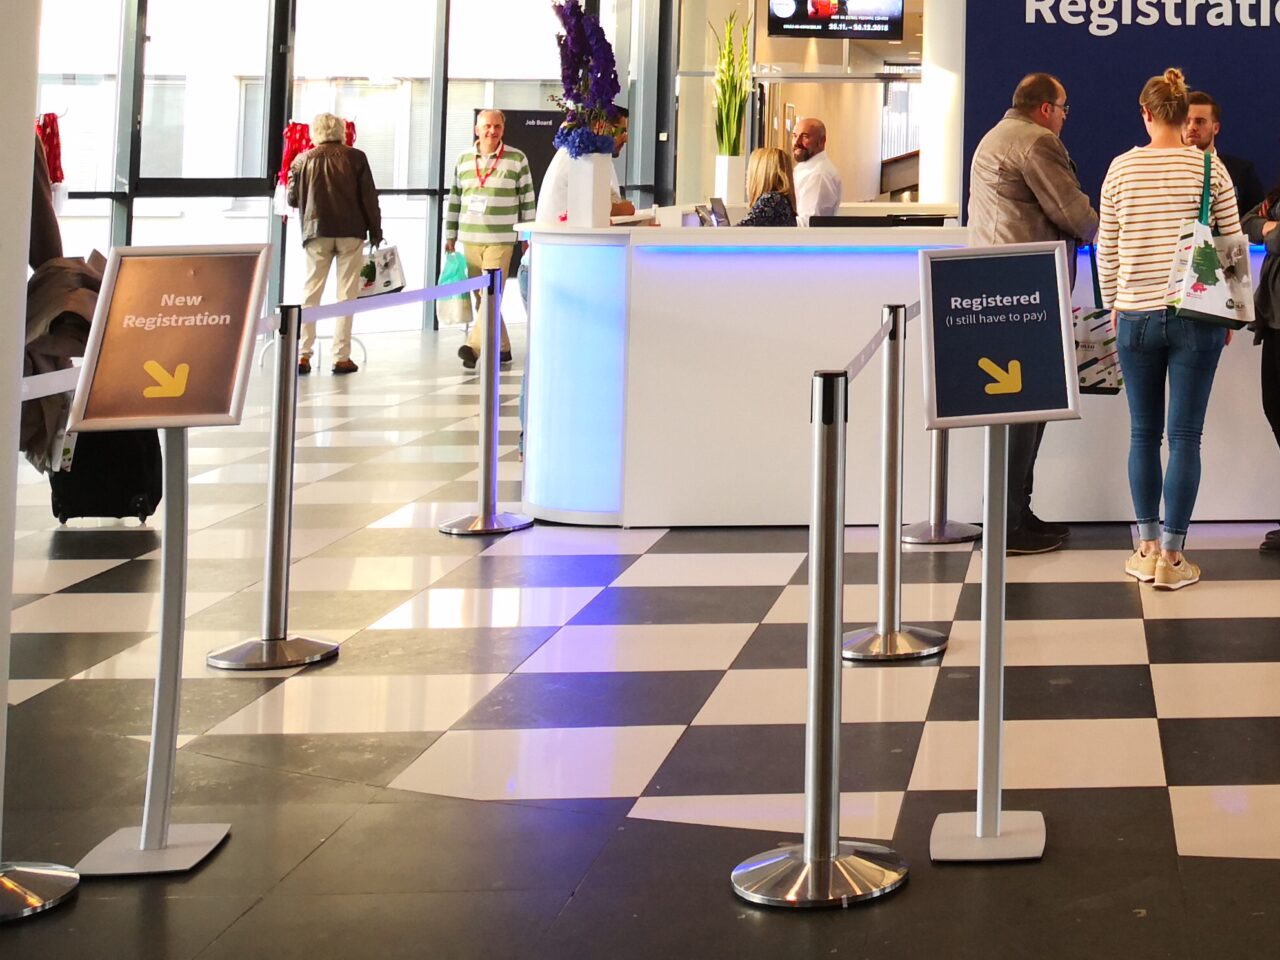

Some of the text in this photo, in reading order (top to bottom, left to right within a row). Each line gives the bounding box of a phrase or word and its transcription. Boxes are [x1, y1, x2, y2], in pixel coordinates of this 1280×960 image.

[160, 293, 203, 307] New
[950, 291, 1040, 311] Registered
[122, 311, 231, 331] Registration
[956, 314, 976, 325] still
[979, 313, 1006, 324] have
[1009, 313, 1020, 322] to
[1023, 310, 1047, 323] pay)
